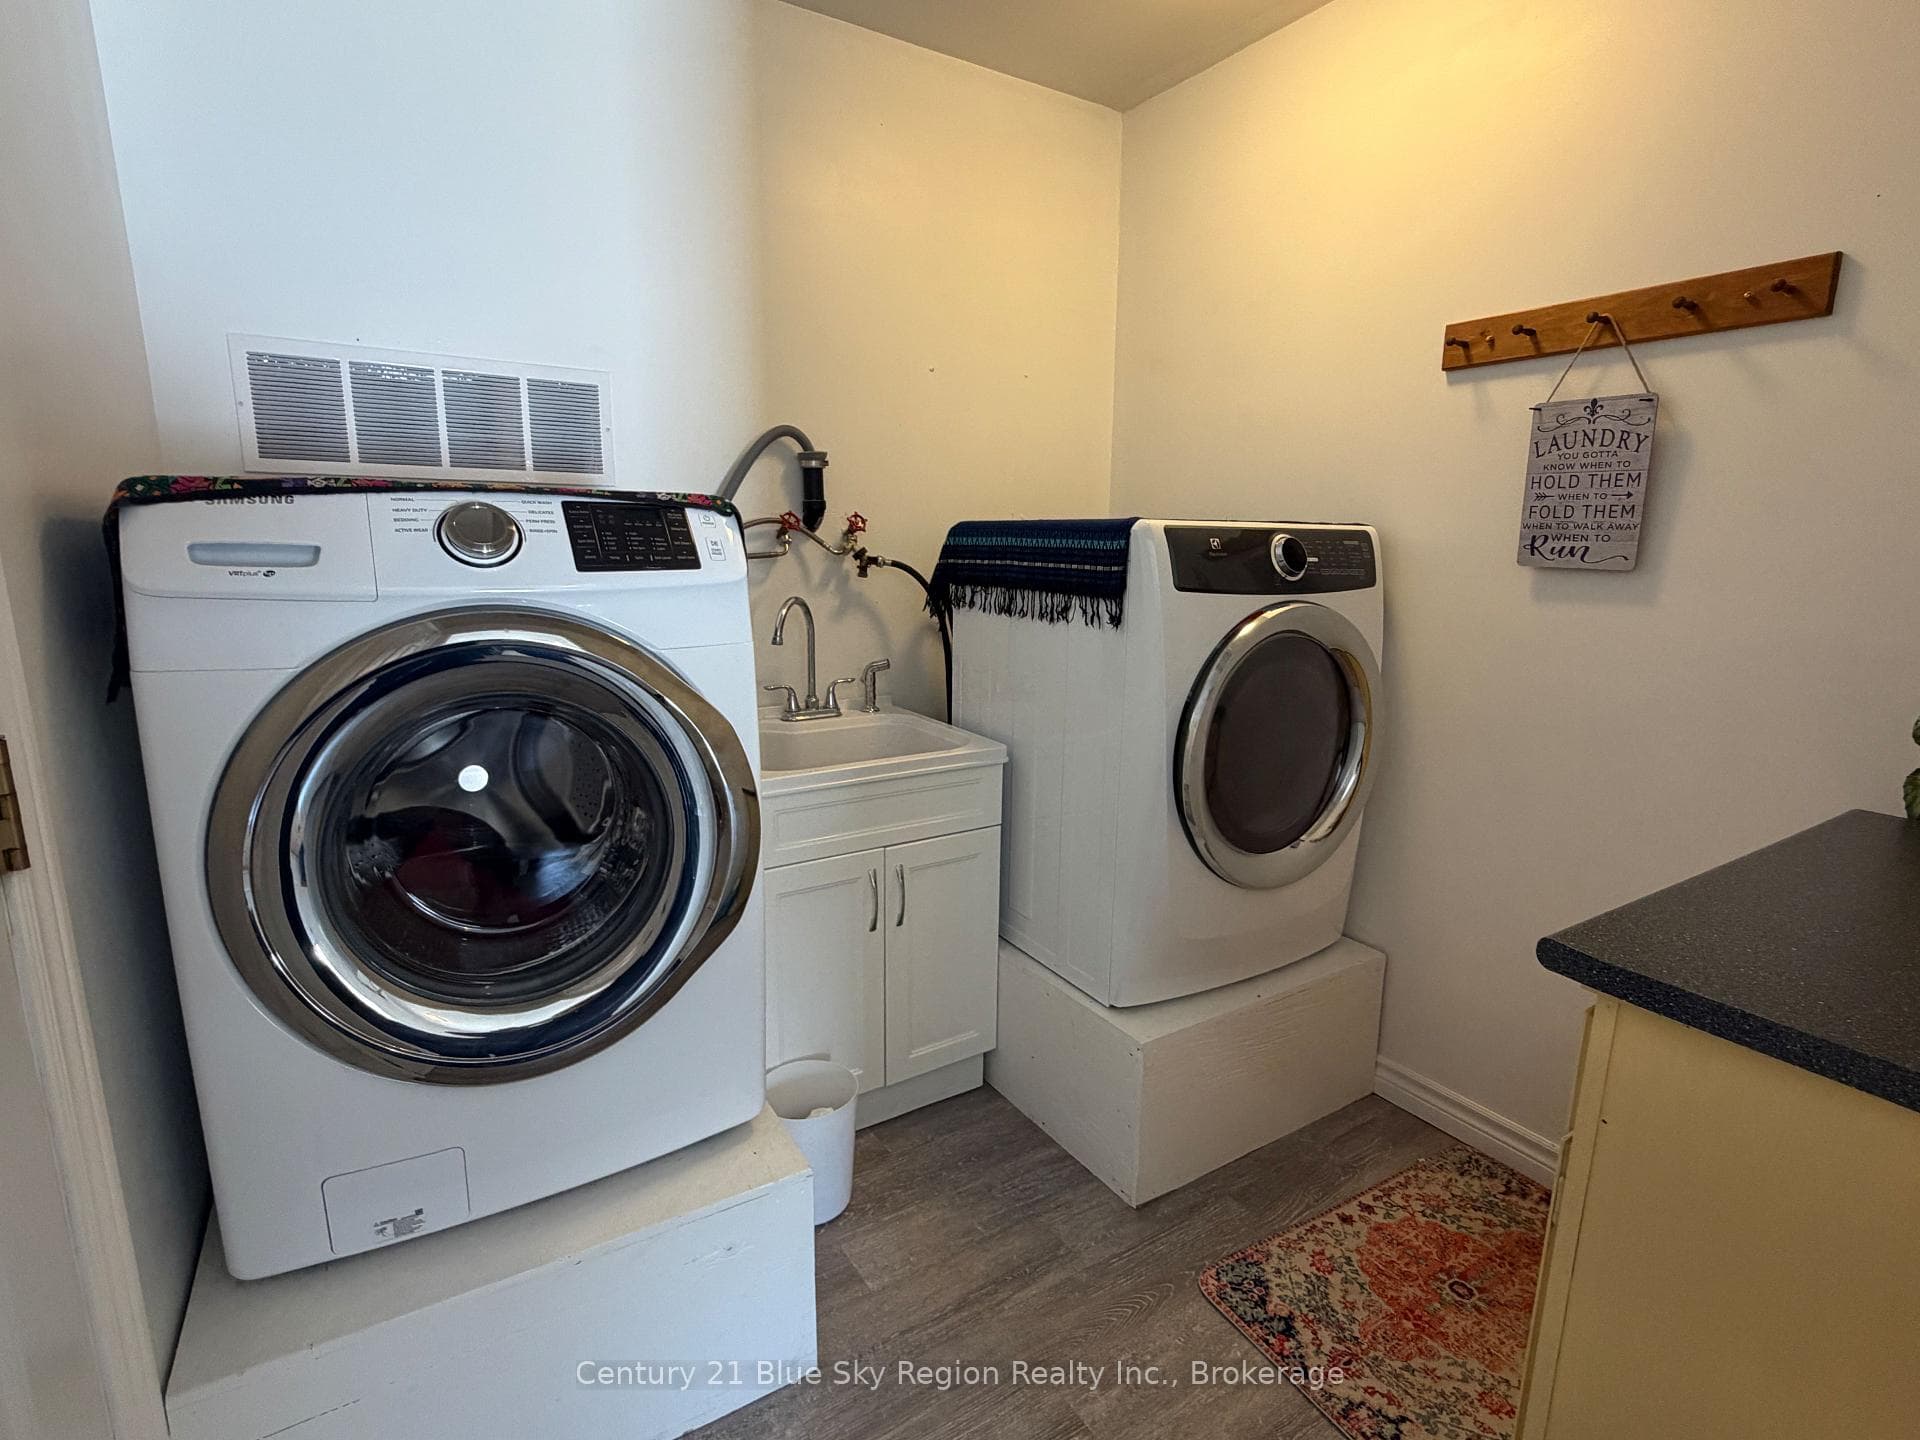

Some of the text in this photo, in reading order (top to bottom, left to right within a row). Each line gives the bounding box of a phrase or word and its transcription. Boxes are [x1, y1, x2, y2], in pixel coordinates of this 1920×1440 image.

[1533, 428, 1649, 458] LAUNDRY
[1583, 450, 1619, 459] GOTTA
[1543, 460, 1631, 471] KNOW WHEN TO
[1530, 472, 1642, 490] HOLD THEM
[1593, 492, 1608, 500] TO
[1529, 504, 1635, 519] FOLD THEM
[1523, 522, 1639, 531] WHEN TO WALK AWAY
[1552, 533, 1611, 542] WHEN TO
[1523, 535, 1629, 563] Run
